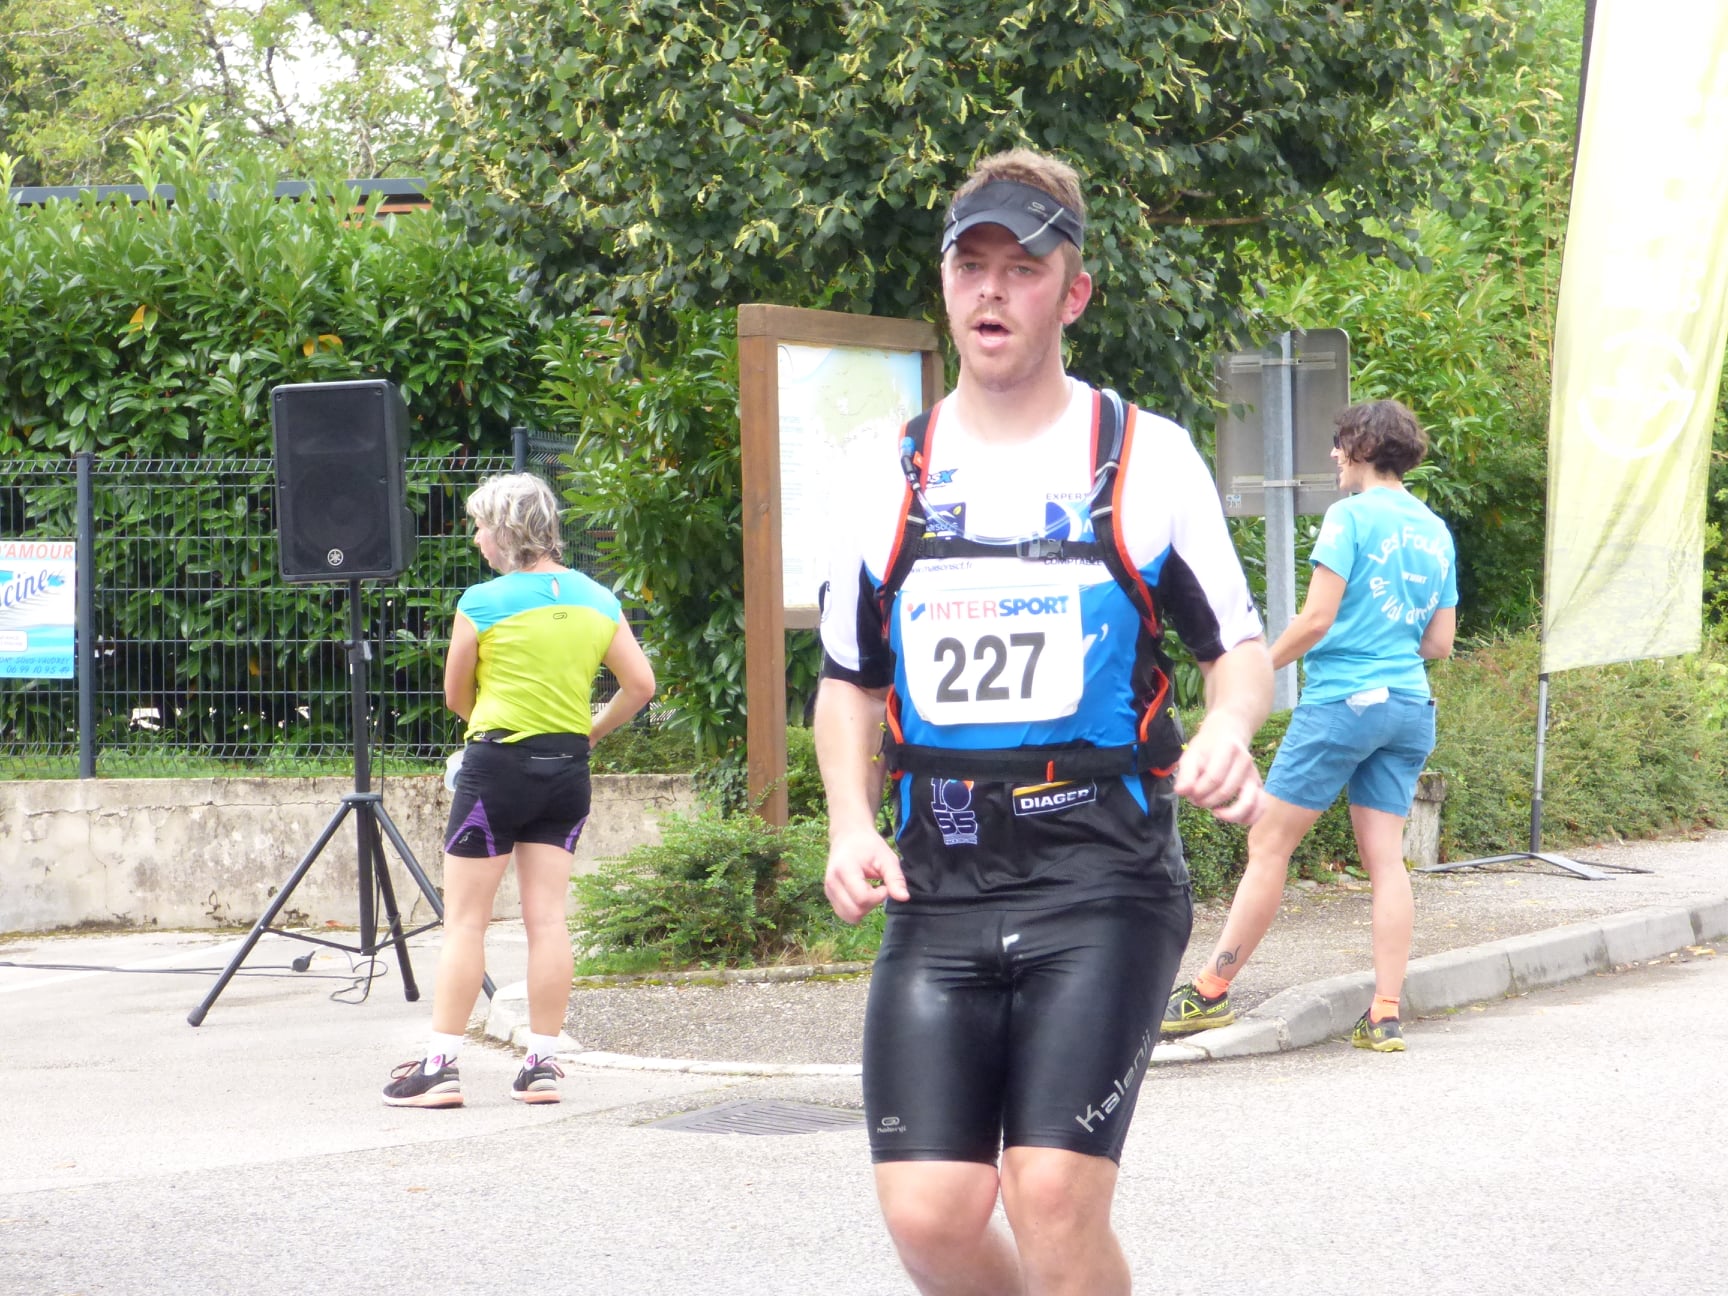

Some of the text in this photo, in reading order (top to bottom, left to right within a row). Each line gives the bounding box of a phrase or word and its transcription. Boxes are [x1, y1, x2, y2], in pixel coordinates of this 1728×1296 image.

[0, 543, 73, 560] 'AMOUR
[0, 568, 47, 608] cine
[930, 595, 1069, 621] INTERSPORT
[1381, 594, 1405, 621] Val
[933, 631, 1046, 704] 227
[1205, 999, 1229, 1015] SCOTT
[1075, 1028, 1151, 1134] Kalenji
